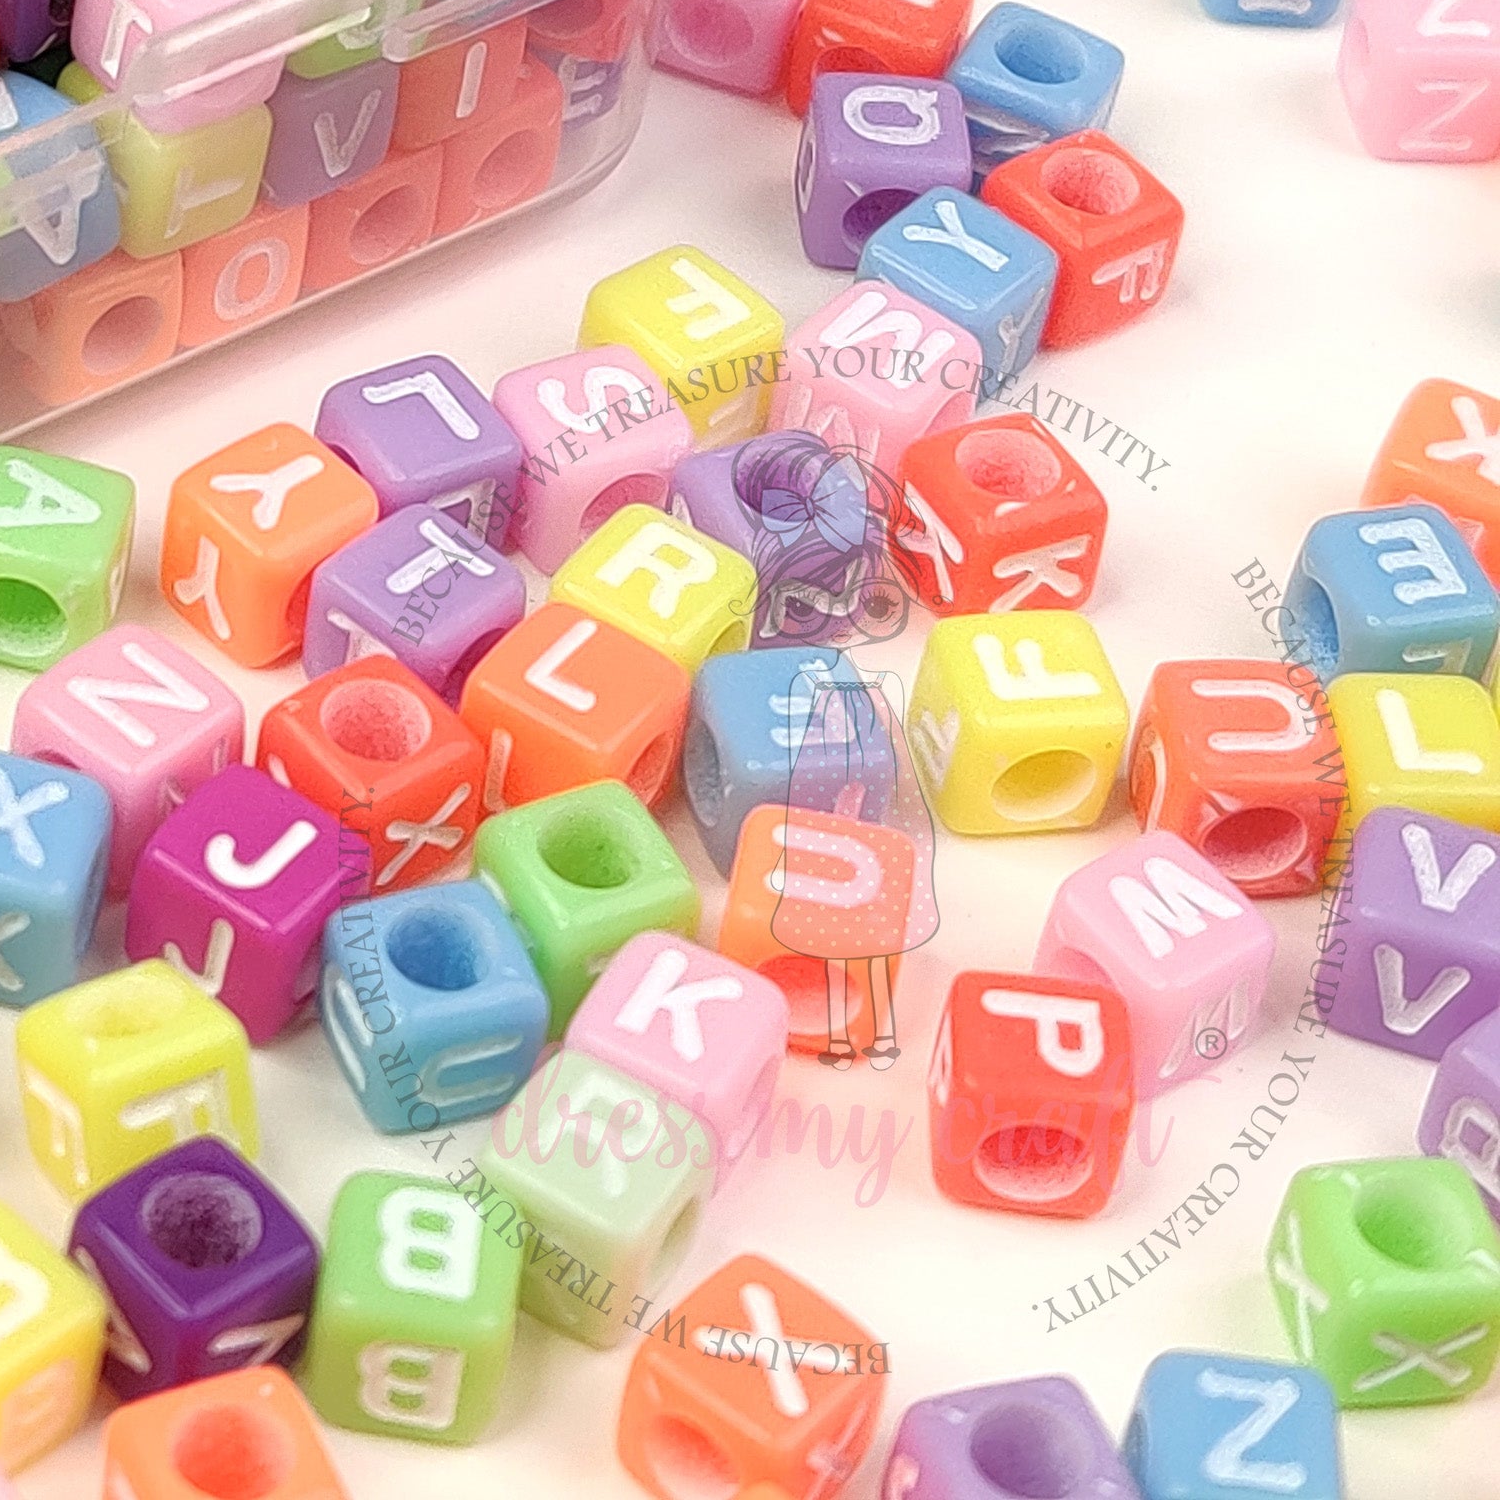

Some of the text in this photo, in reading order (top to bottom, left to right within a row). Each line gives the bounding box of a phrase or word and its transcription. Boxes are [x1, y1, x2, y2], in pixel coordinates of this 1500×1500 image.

[313, 89, 382, 178] V
[842, 84, 942, 146] Q
[1396, 78, 1490, 151] Z
[902, 200, 1010, 272] Y
[1091, 242, 1167, 304] F
[665, 256, 752, 341] F
[361, 370, 480, 441] L
[536, 365, 651, 434] S
[209, 453, 325, 531] Y
[173, 534, 231, 642] Y
[385, 518, 496, 595] T
[594, 521, 718, 619] R
[986, 534, 1093, 615] K
[1358, 517, 1468, 605] E
[524, 618, 598, 713] L
[973, 633, 1103, 701] F
[1190, 679, 1317, 753] U
[1373, 688, 1484, 775] L
[203, 819, 318, 890] J
[374, 782, 472, 887] X
[1401, 822, 1497, 913] V
[1107, 857, 1245, 960] M
[613, 948, 744, 1064] K
[980, 988, 1105, 1079] P
[1372, 943, 1471, 1037] V
[377, 1185, 484, 1300] B
[359, 1341, 466, 1430] B
[692, 1282, 858, 1418] X
[1352, 1323, 1489, 1393] X
[1198, 1366, 1307, 1490] Z
